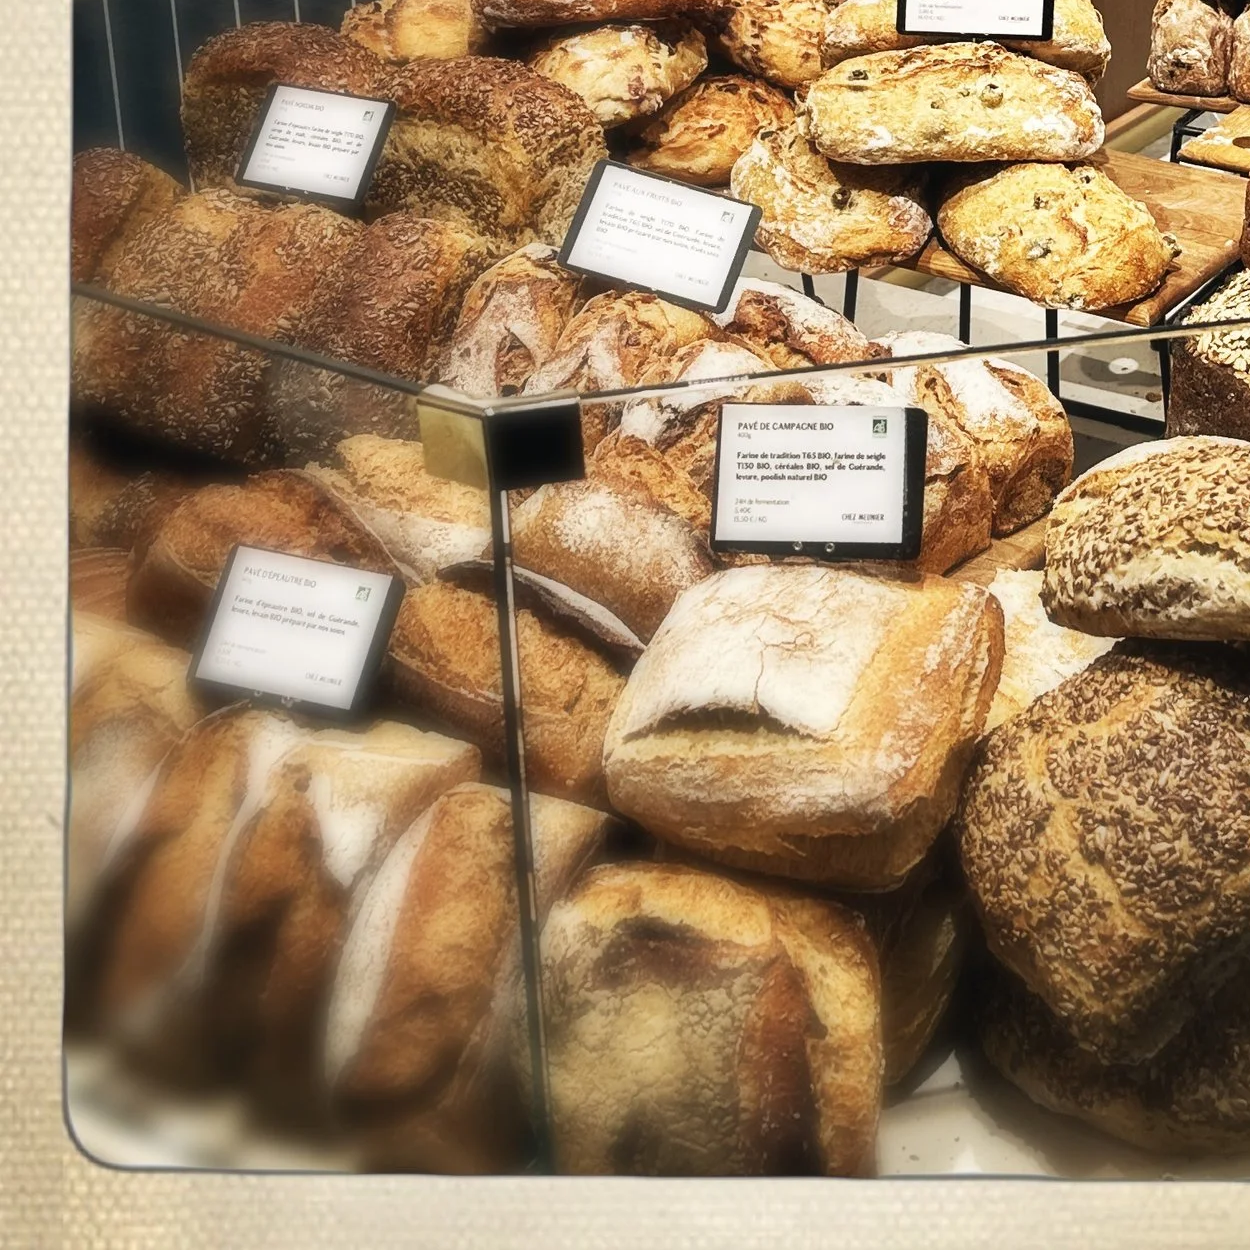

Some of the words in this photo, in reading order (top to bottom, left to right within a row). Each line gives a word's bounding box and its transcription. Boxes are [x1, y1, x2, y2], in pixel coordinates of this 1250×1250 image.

[738, 421, 758, 430] PAVÉ
[760, 422, 770, 430] DE
[817, 452, 833, 460] BIO,
[834, 452, 855, 460] farine
[866, 453, 886, 462] seigle
[736, 473, 759, 481] levure,
[761, 473, 786, 482] poolish
[814, 473, 827, 481] BIO
[244, 567, 262, 577] PAVÉ
[304, 579, 316, 588] BIO
